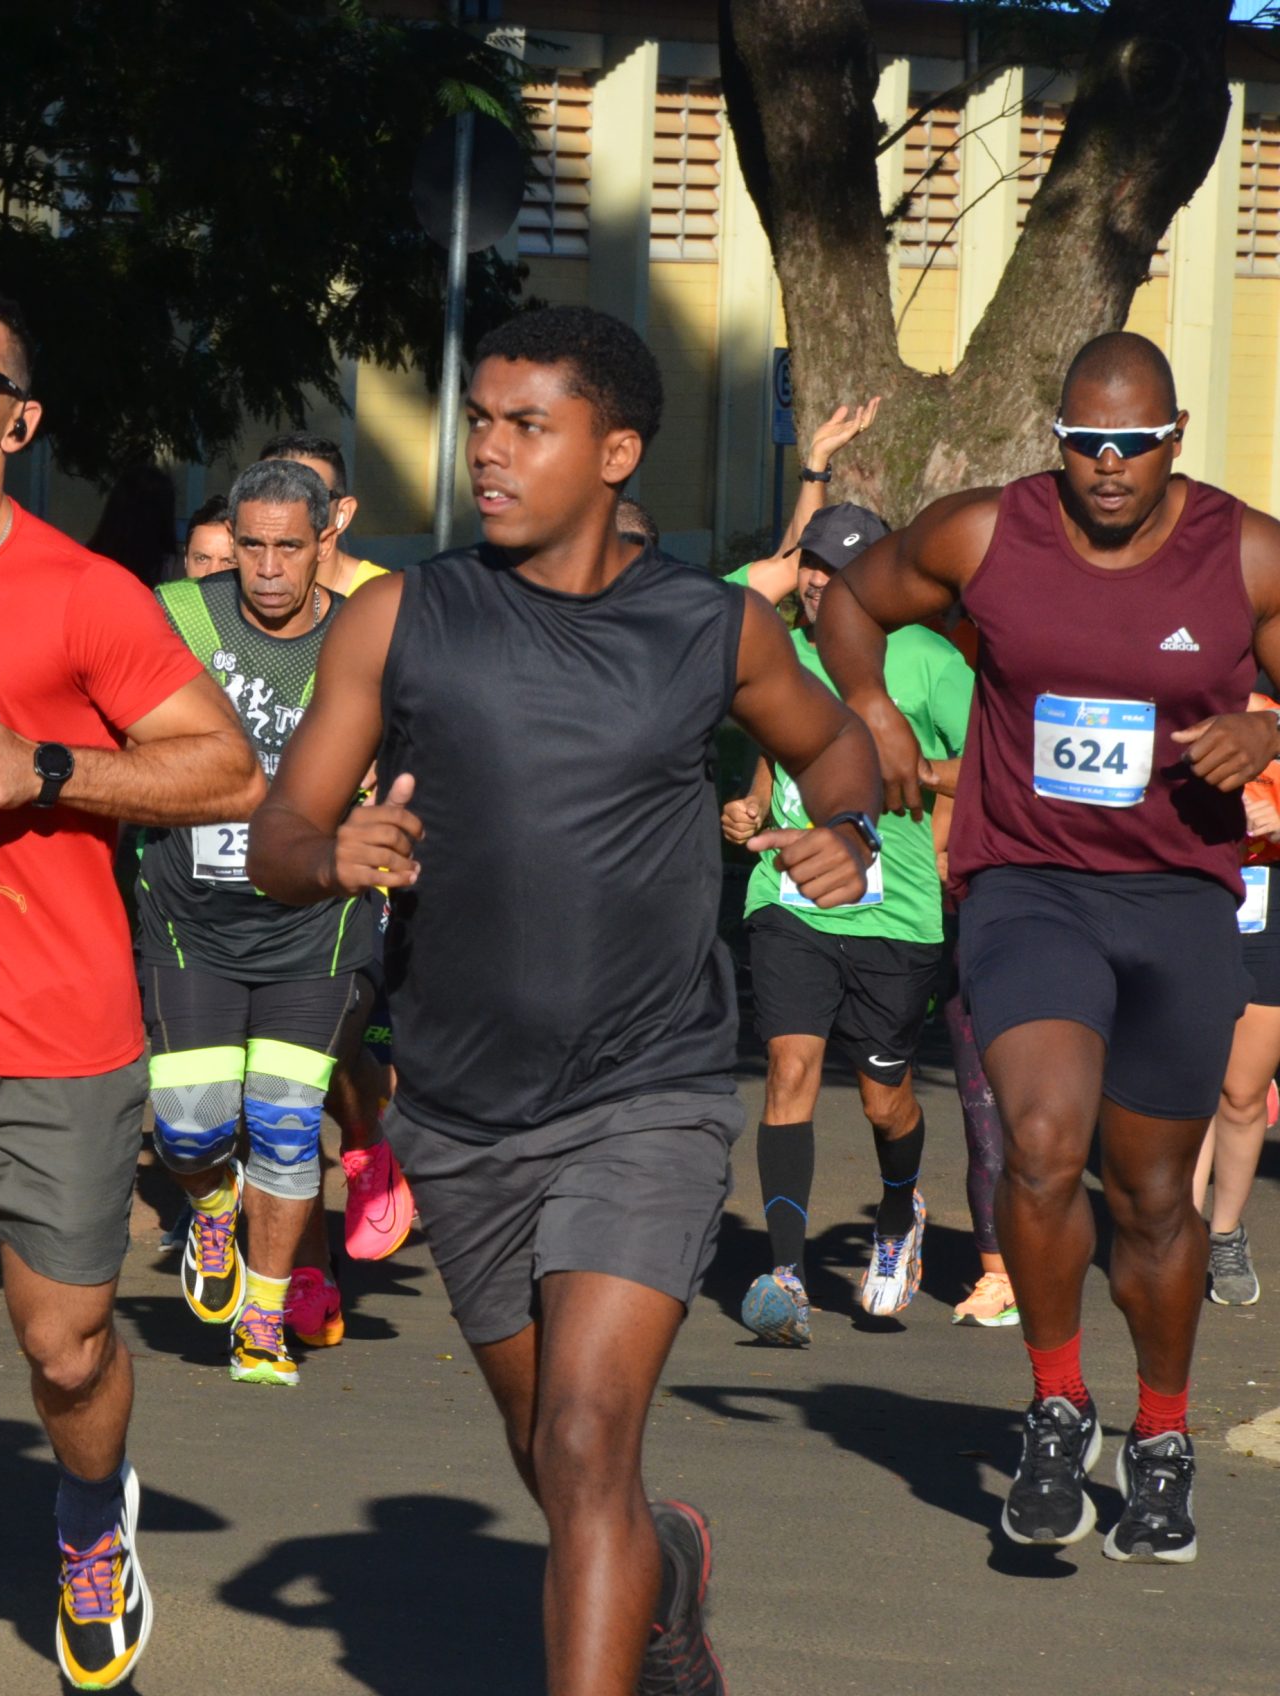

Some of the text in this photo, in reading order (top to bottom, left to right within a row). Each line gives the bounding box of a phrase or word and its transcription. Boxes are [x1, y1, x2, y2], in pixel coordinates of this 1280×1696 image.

[1160, 642, 1200, 651] adidas
[213, 650, 237, 671] OS
[1053, 737, 1128, 774] 624
